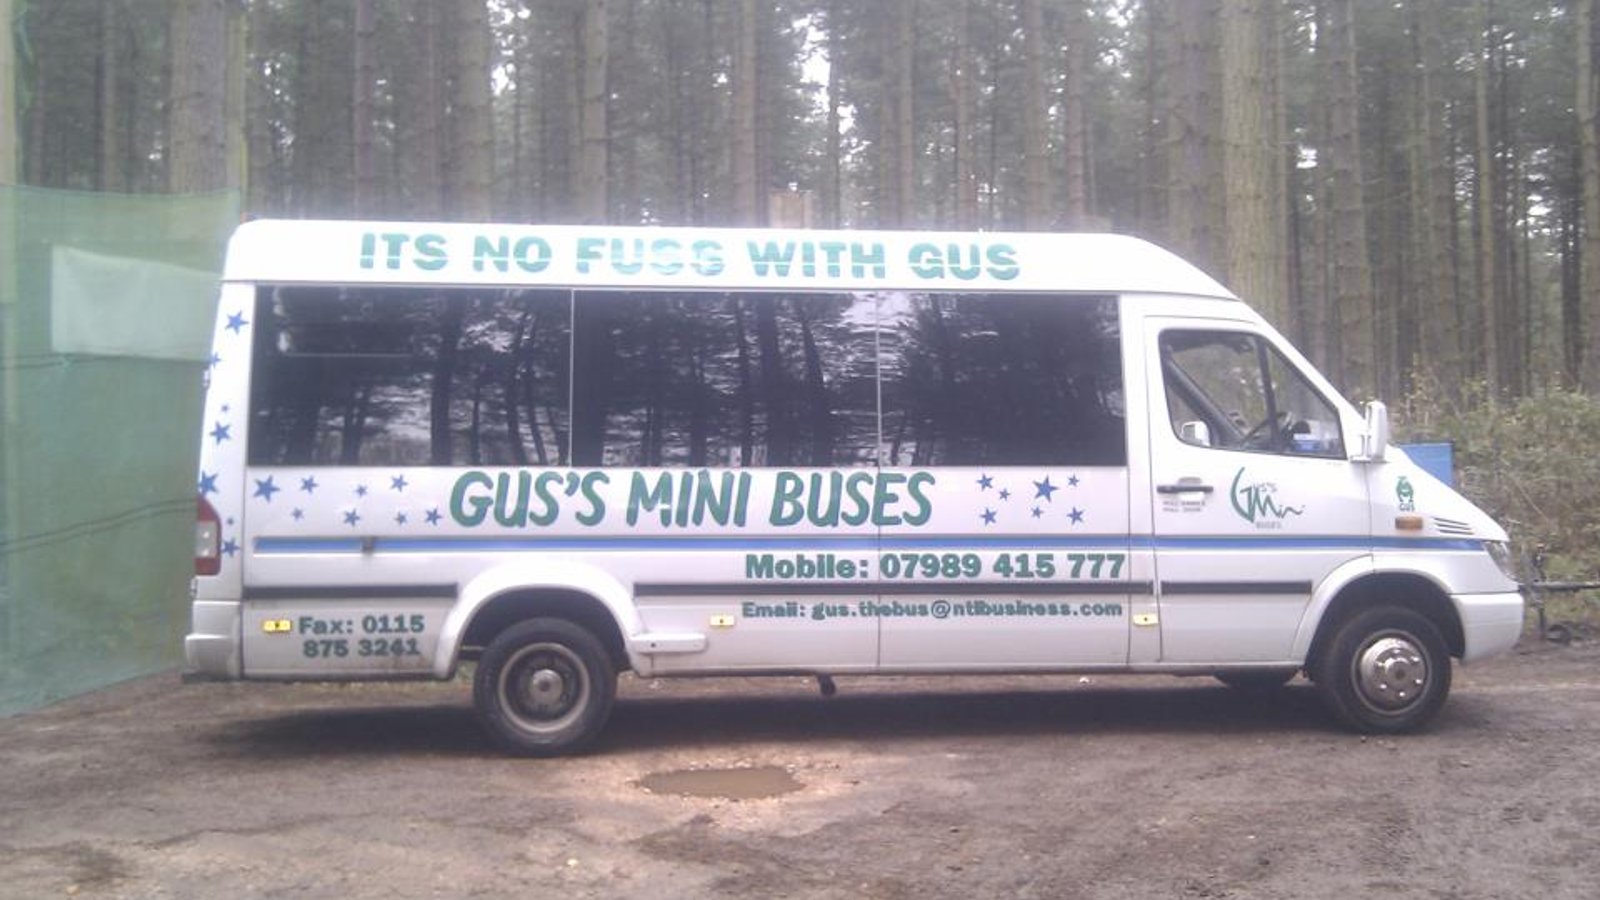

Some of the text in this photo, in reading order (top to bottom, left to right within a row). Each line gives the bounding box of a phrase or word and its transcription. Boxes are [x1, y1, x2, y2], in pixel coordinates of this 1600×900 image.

[361, 233, 1020, 281] ITS NO FUSS WITH GUS
[449, 469, 936, 529] GUS'S MINI BUSES
[745, 553, 1126, 579] Mobile: 07989 415 777
[742, 601, 806, 618] Email:
[298, 615, 425, 634] Fax: 0115
[303, 638, 421, 658] 875 3241
